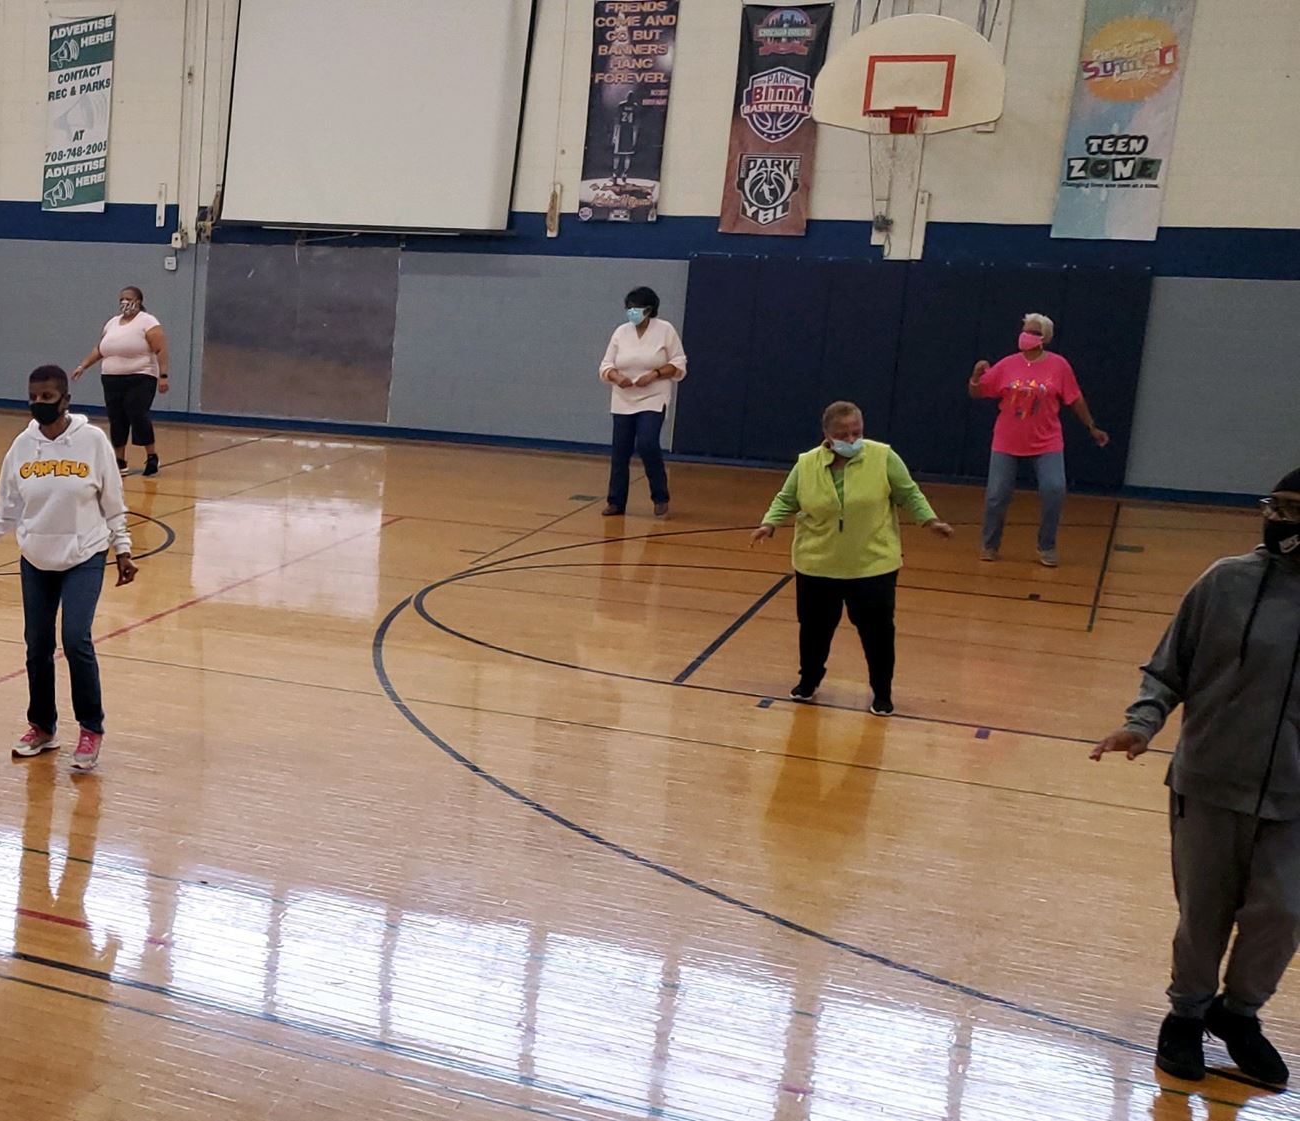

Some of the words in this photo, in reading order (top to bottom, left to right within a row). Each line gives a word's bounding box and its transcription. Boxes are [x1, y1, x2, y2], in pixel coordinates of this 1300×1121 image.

[605, 2, 668, 13] FRIENDS
[51, 16, 113, 41] ADVERTISE
[595, 17, 640, 28] COME
[644, 15, 676, 26] AND
[80, 31, 114, 49] HERE!
[633, 30, 661, 40] BUT
[598, 44, 668, 56] BANNERS
[609, 59, 654, 70] HANG
[57, 65, 102, 85] CONTACT
[766, 72, 791, 84] PARK
[47, 88, 68, 102] REC
[70, 86, 77, 97] &
[79, 78, 111, 96] PARKS
[752, 86, 804, 103] BITTY
[621, 112, 634, 123] 24
[744, 104, 810, 115] BASKETBALL
[72, 129, 85, 142] AT
[1085, 135, 1149, 155] TEEN
[45, 157, 105, 179] ADVERTISE
[747, 159, 795, 178] PARK
[1067, 158, 1162, 181] ZONE
[742, 201, 789, 225] YBL
[19, 459, 91, 479] GARFIELD
